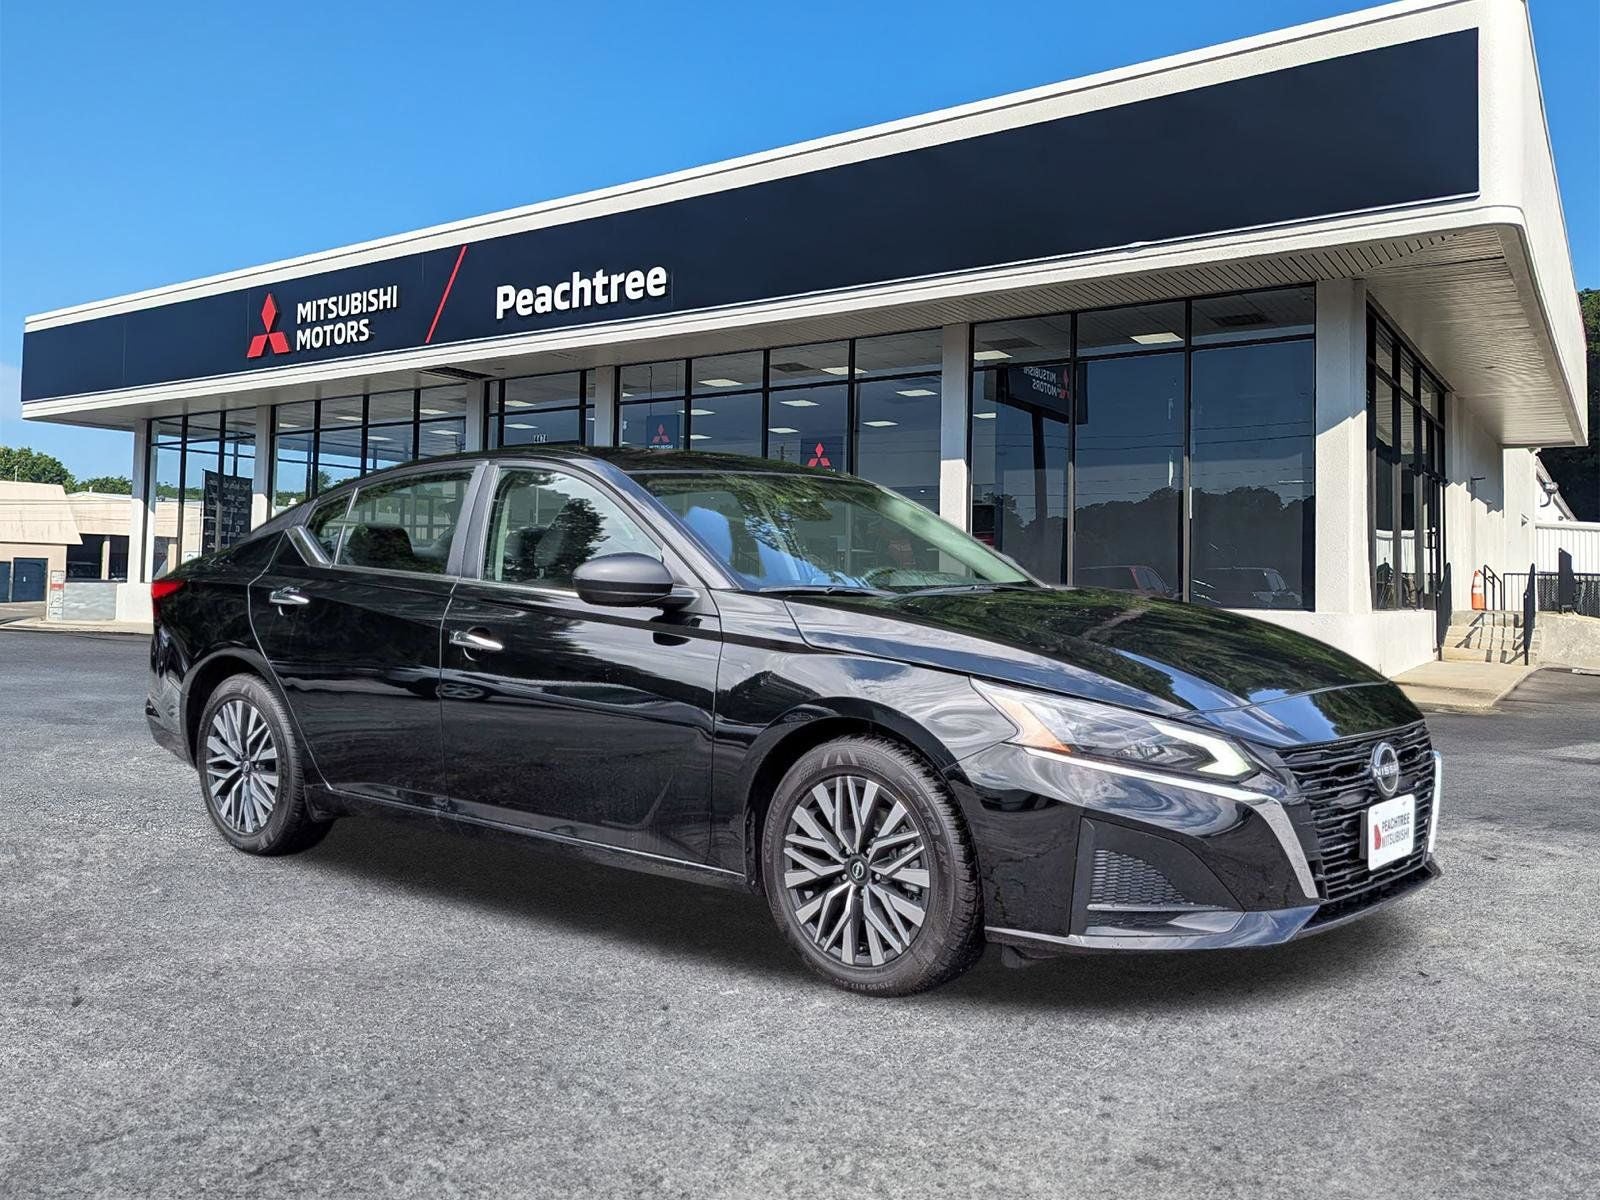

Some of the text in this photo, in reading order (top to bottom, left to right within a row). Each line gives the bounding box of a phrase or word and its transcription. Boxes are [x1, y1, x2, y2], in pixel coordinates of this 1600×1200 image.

[296, 285, 398, 324] MITSUBISHI
[496, 266, 667, 319] Peachtree
[296, 319, 370, 351] MOTORS
[1381, 812, 1410, 833] PEACHTREE
[1381, 827, 1410, 849] MITSUBISHI
